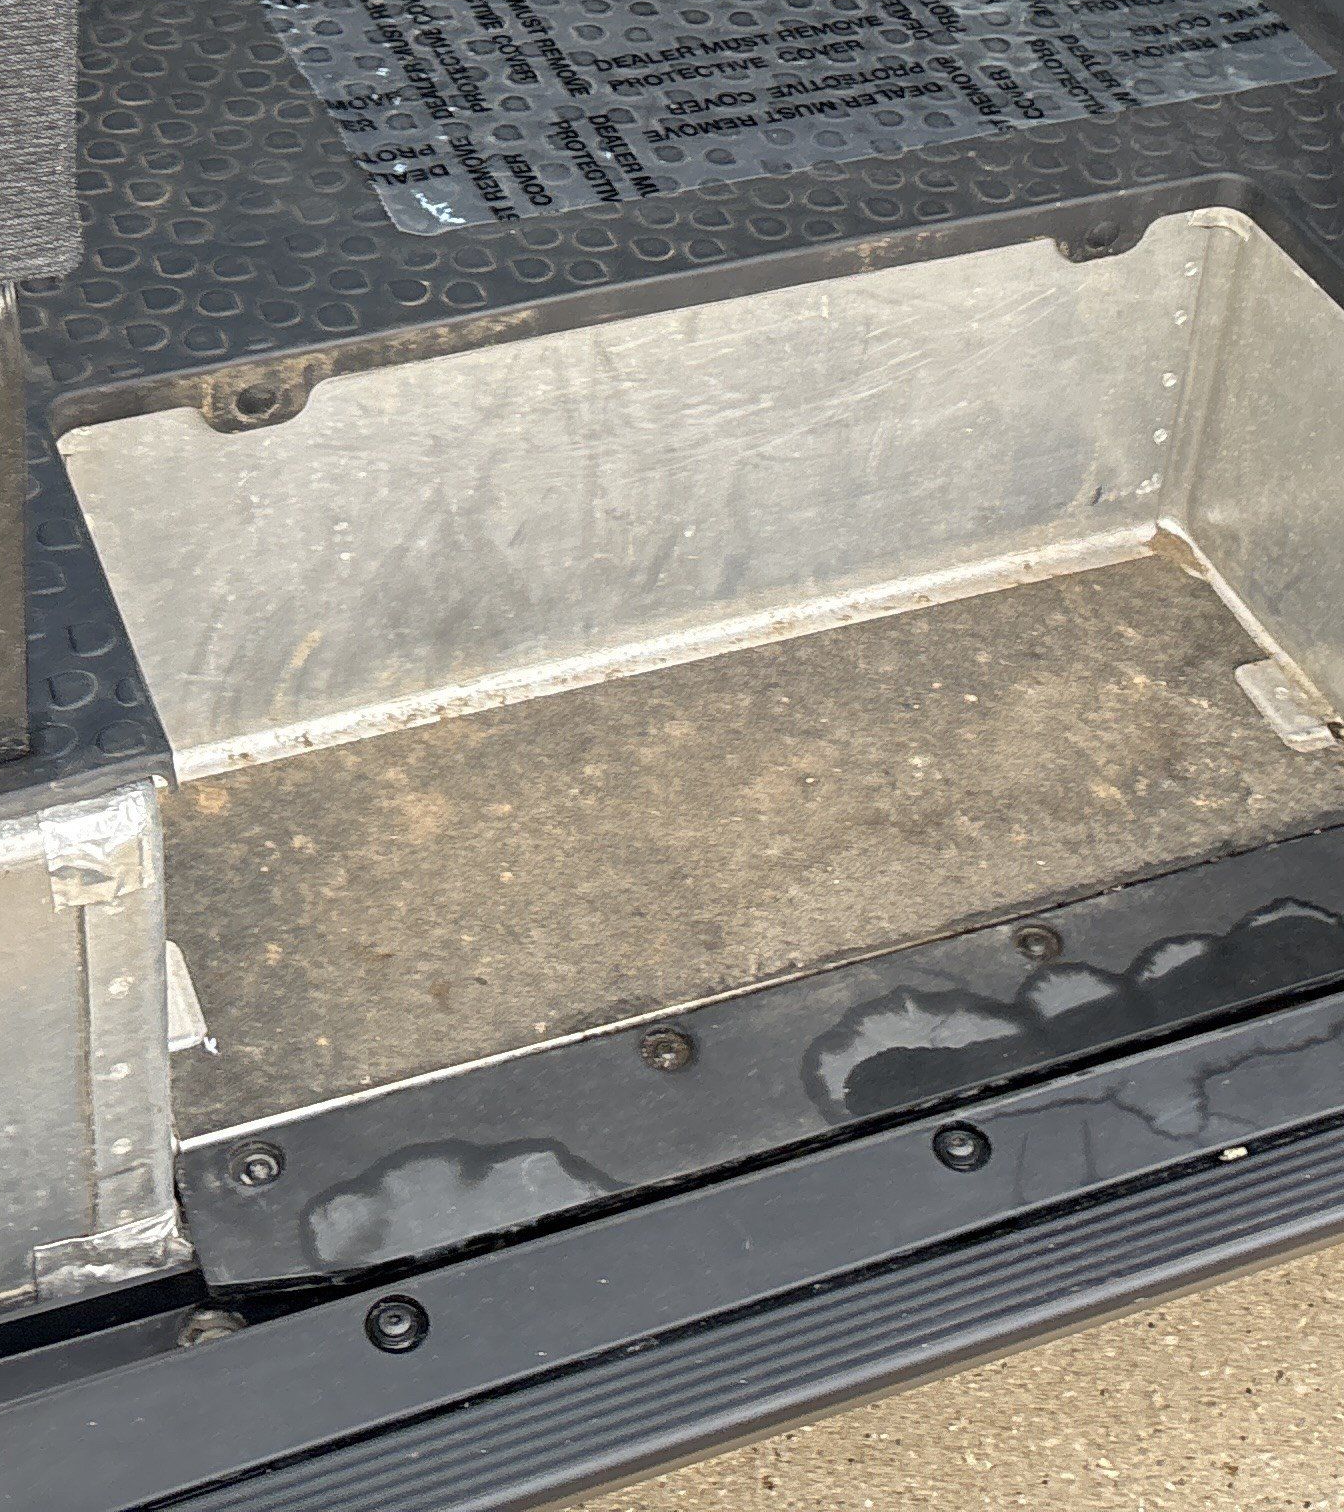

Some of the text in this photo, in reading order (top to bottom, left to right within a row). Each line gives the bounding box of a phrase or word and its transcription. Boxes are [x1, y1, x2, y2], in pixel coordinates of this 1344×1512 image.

[492, 34, 541, 86] COVER
[533, 36, 593, 98] REMOVE
[594, 14, 885, 73] DEALER MUST REMOVE
[607, 39, 867, 93] PROTECTIVE COVER
[642, 80, 944, 144] DEALER MUST REMOVE
[665, 59, 927, 117] PROTECTIVE COVER
[449, 135, 510, 202] REMOVE
[587, 113, 645, 174] DEALER
[504, 152, 554, 207] COVER
